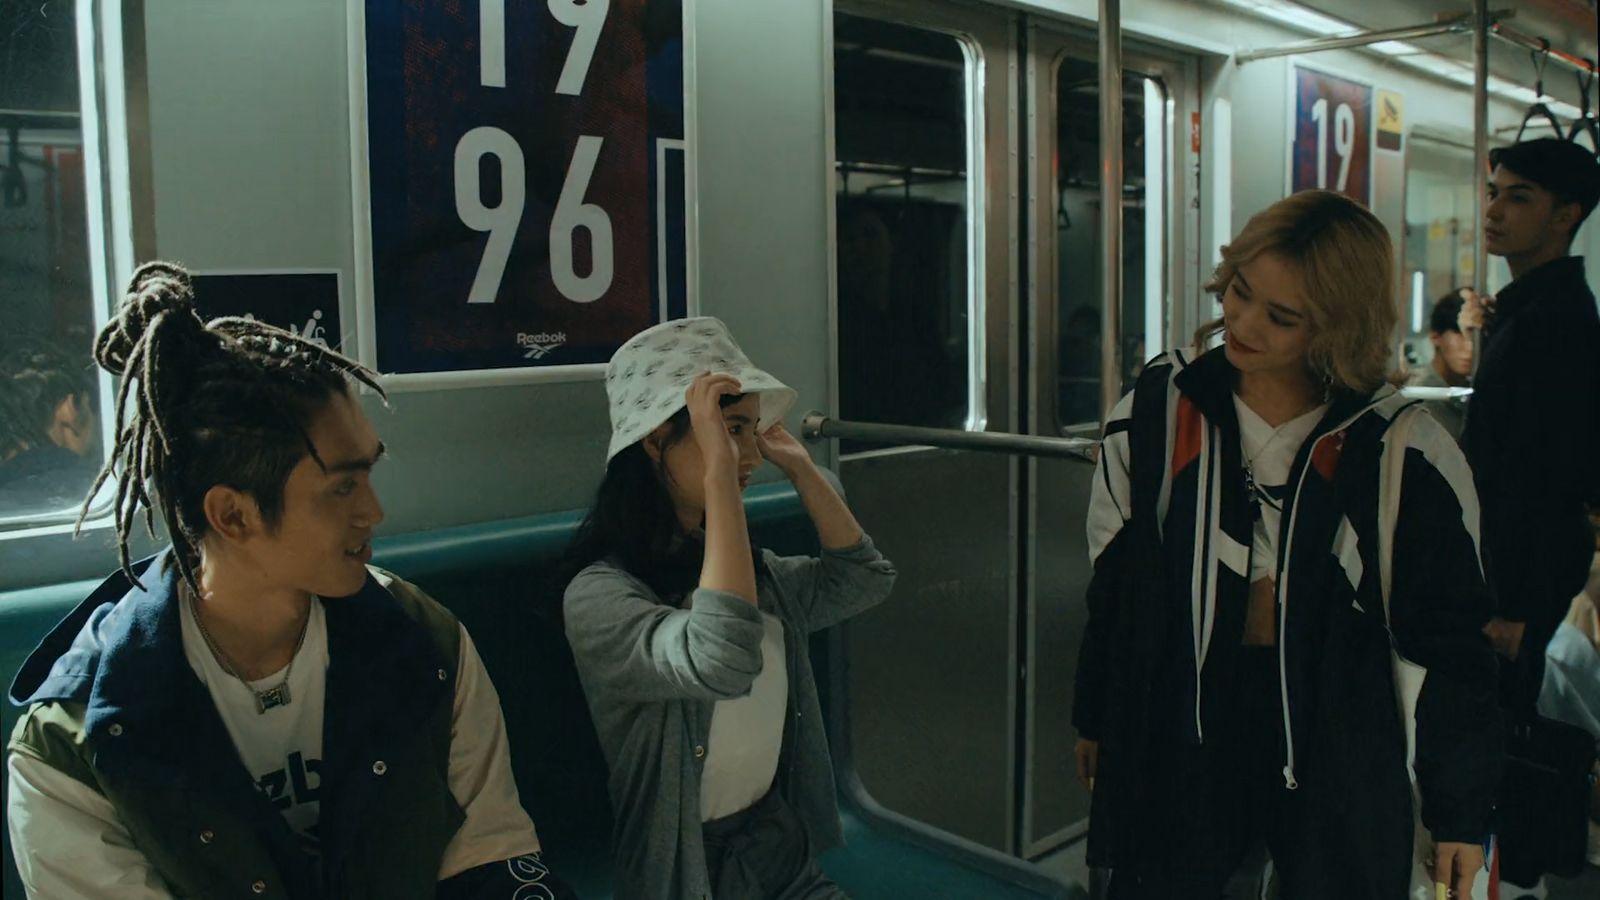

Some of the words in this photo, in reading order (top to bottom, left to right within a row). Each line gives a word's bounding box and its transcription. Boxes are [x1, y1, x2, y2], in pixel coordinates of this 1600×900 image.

[1311, 98, 1355, 192] 19
[454, 126, 614, 303] 96
[516, 331, 567, 346] Reebok
